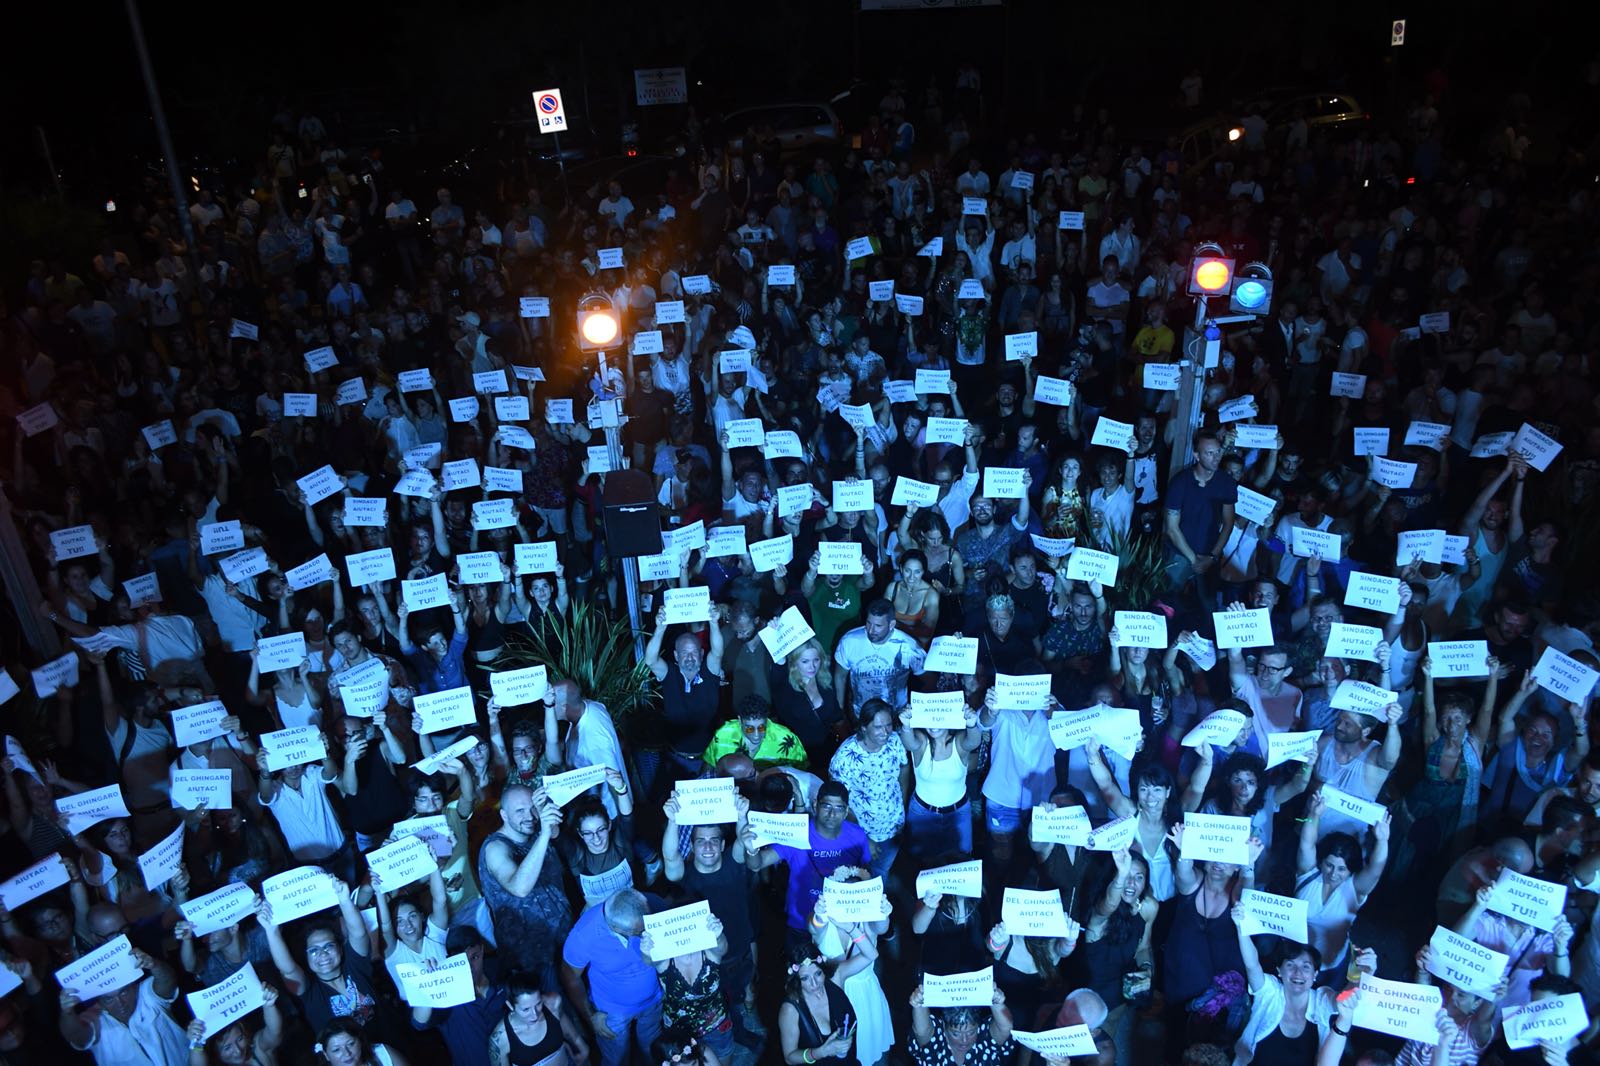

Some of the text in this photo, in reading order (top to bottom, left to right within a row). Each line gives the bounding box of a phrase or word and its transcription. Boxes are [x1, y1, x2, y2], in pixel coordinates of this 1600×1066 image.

[1106, 421, 1129, 430] SINDACO
[1528, 429, 1553, 446] SINDACO
[1524, 437, 1546, 452] AIUTACI
[1520, 446, 1536, 459] TU!!
[318, 486, 331, 496] TU!!
[905, 481, 930, 490] SINDACO
[904, 489, 927, 499] AIUTACI
[226, 548, 254, 562] SINDACO
[1080, 550, 1109, 560] SINDACO
[361, 562, 383, 570] AIUTACI
[1079, 560, 1106, 569] AIUTACI
[240, 566, 257, 576] TU!!
[1360, 576, 1392, 584] SINDACO
[412, 586, 438, 596] AIUTACI
[1360, 586, 1389, 594] AIUTACI
[1362, 597, 1382, 606] TU!!
[1131, 635, 1150, 643] TU!!
[1448, 663, 1470, 671] TU!!
[1554, 654, 1587, 674] SINDACO
[508, 671, 544, 681] GHINGARO
[1550, 665, 1580, 682] AIUTACI
[506, 683, 534, 691] AIUTACI
[1352, 681, 1388, 699] SINDACO
[1550, 678, 1569, 693] TU!!
[432, 693, 470, 706] GHINGARO
[431, 704, 460, 716] AIUTACI
[190, 718, 218, 728] AIUTACI
[1051, 712, 1100, 730] DEL GHINGARO
[272, 728, 307, 740] SINDACO
[1066, 726, 1091, 736] AIUTACI
[276, 738, 308, 749] AIUTACI
[285, 750, 307, 761] TU!!
[693, 785, 733, 793] GHINGARO
[60, 792, 118, 812] DEL GHINGARO
[1340, 800, 1362, 813] TU!!
[765, 819, 806, 827] GHINGARO
[1203, 823, 1248, 831] GHINGARO
[814, 849, 842, 858] DENIM
[388, 854, 418, 870] AIUTACI
[400, 867, 414, 877] TU!!
[840, 885, 882, 894] GHINGARO
[1510, 874, 1554, 893] SINDACO
[282, 884, 316, 901] AIUTACI
[1507, 888, 1548, 906] AIUTACI
[295, 899, 312, 909] TU!!
[1251, 894, 1293, 908] SINDACO
[1252, 908, 1290, 920] AIUTACI
[1511, 904, 1538, 918] TU!!
[647, 909, 708, 930] DEL GHINGARO
[664, 924, 697, 937] AIUTACI
[1260, 920, 1284, 932] TU!!
[676, 938, 690, 946] TU!!
[1447, 935, 1492, 960] SINDACO
[63, 942, 128, 984] DEL GHINGARO
[1443, 950, 1486, 973] AIUTACI
[84, 962, 120, 986] AIUTACI
[946, 975, 992, 984] GHINGARO
[1446, 967, 1472, 985] TU!!
[99, 976, 116, 989] TU!!
[202, 973, 244, 1000] SINDACO
[419, 976, 454, 989] AIUTACI
[210, 986, 248, 1010] AIUTACI
[430, 992, 448, 1000] TU!!
[1361, 983, 1440, 1004] DEL GHINGARO
[220, 1000, 247, 1018] TU!!
[1378, 1001, 1420, 1015] AIUTACI
[1388, 1018, 1408, 1028] TU!!
[1521, 1018, 1566, 1031] AIUTACI
